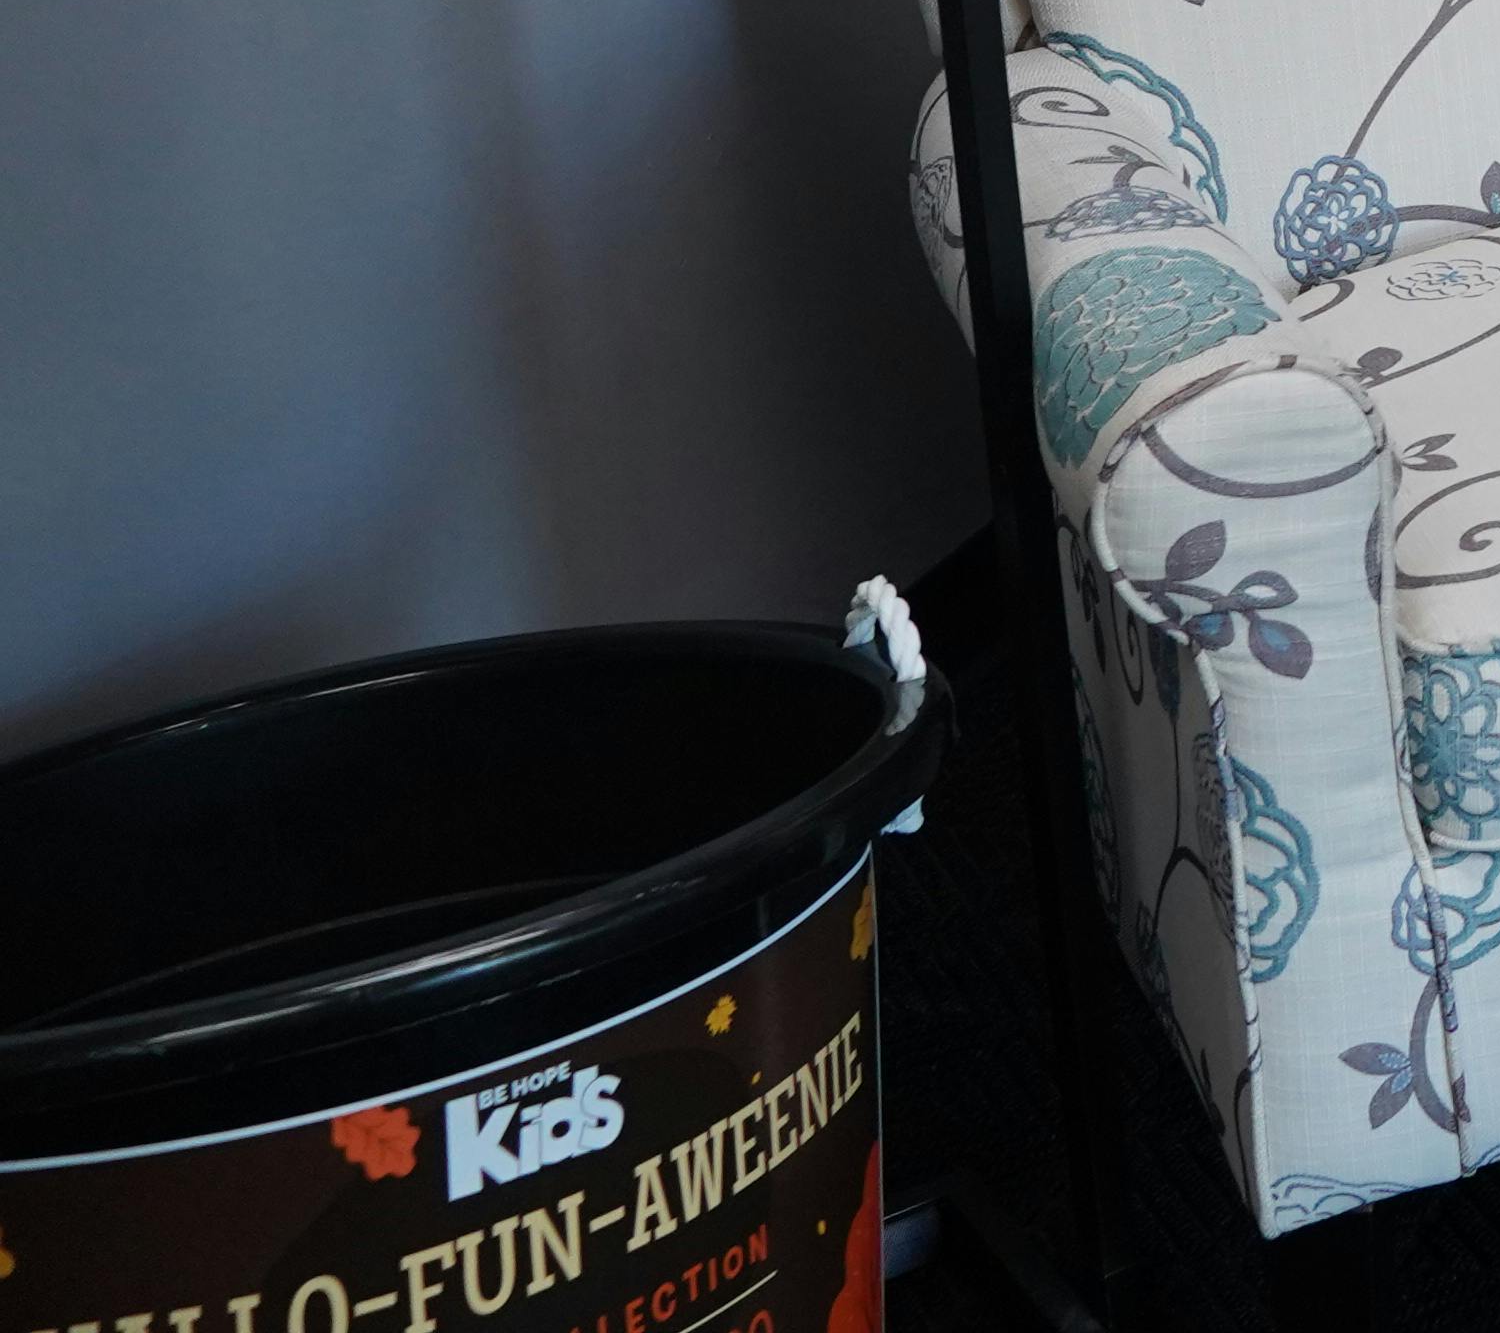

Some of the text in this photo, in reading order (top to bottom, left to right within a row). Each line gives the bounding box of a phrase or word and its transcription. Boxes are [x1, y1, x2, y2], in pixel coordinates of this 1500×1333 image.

[479, 1060, 573, 1111] BE HOPE
[445, 1064, 625, 1203] Kids
